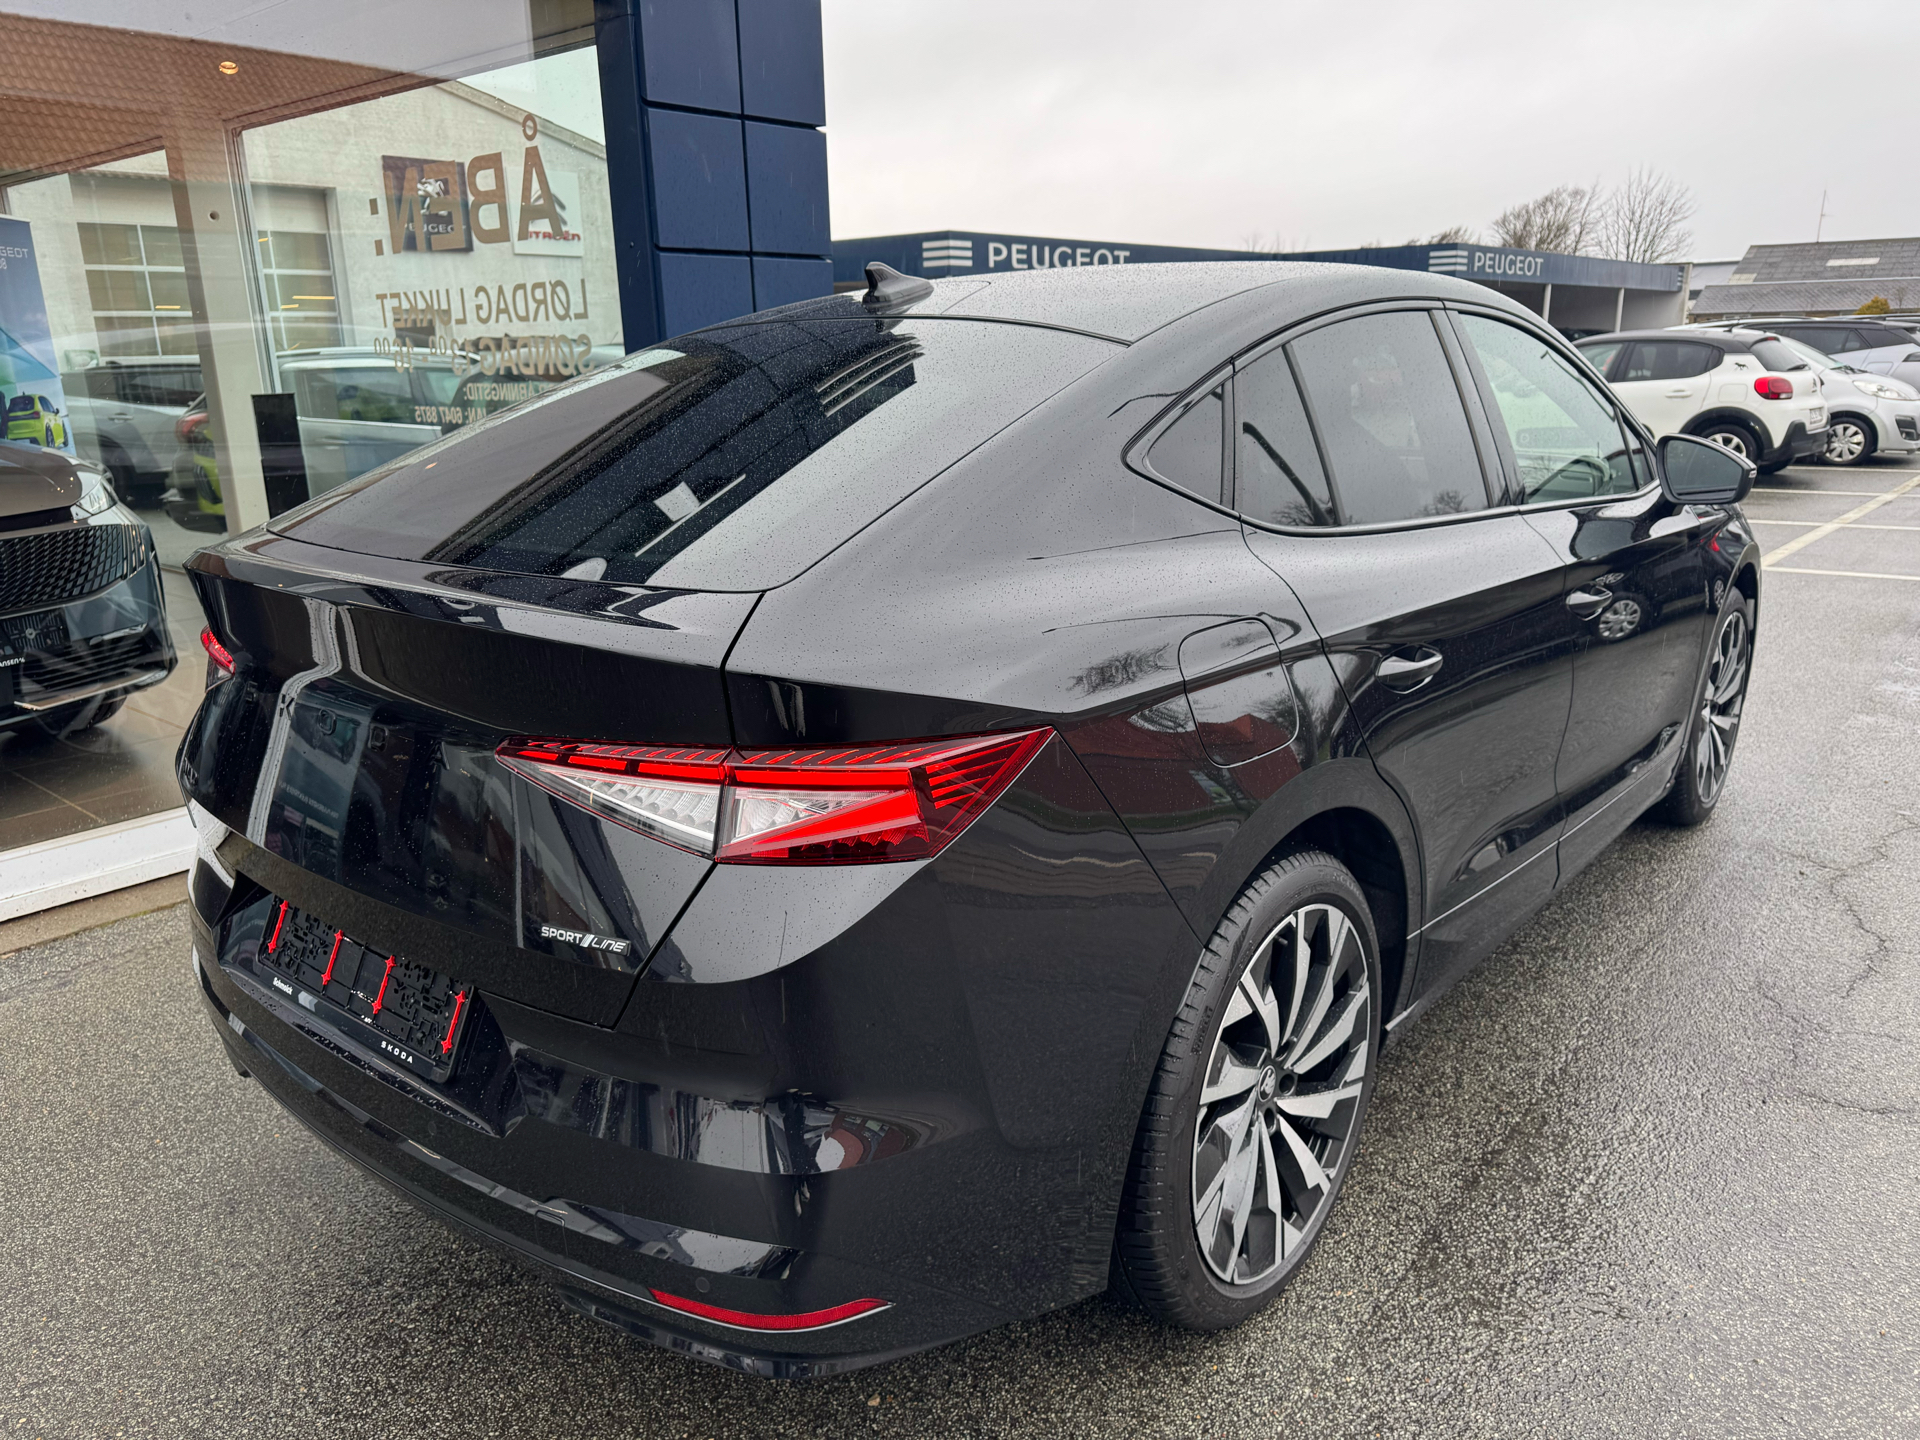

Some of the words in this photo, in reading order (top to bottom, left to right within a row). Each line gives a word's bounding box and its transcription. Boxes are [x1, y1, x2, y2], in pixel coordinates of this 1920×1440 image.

[404, 222, 467, 234] EGEO
[1473, 251, 1544, 277] PEUGEOT
[540, 926, 583, 944] SPORT
